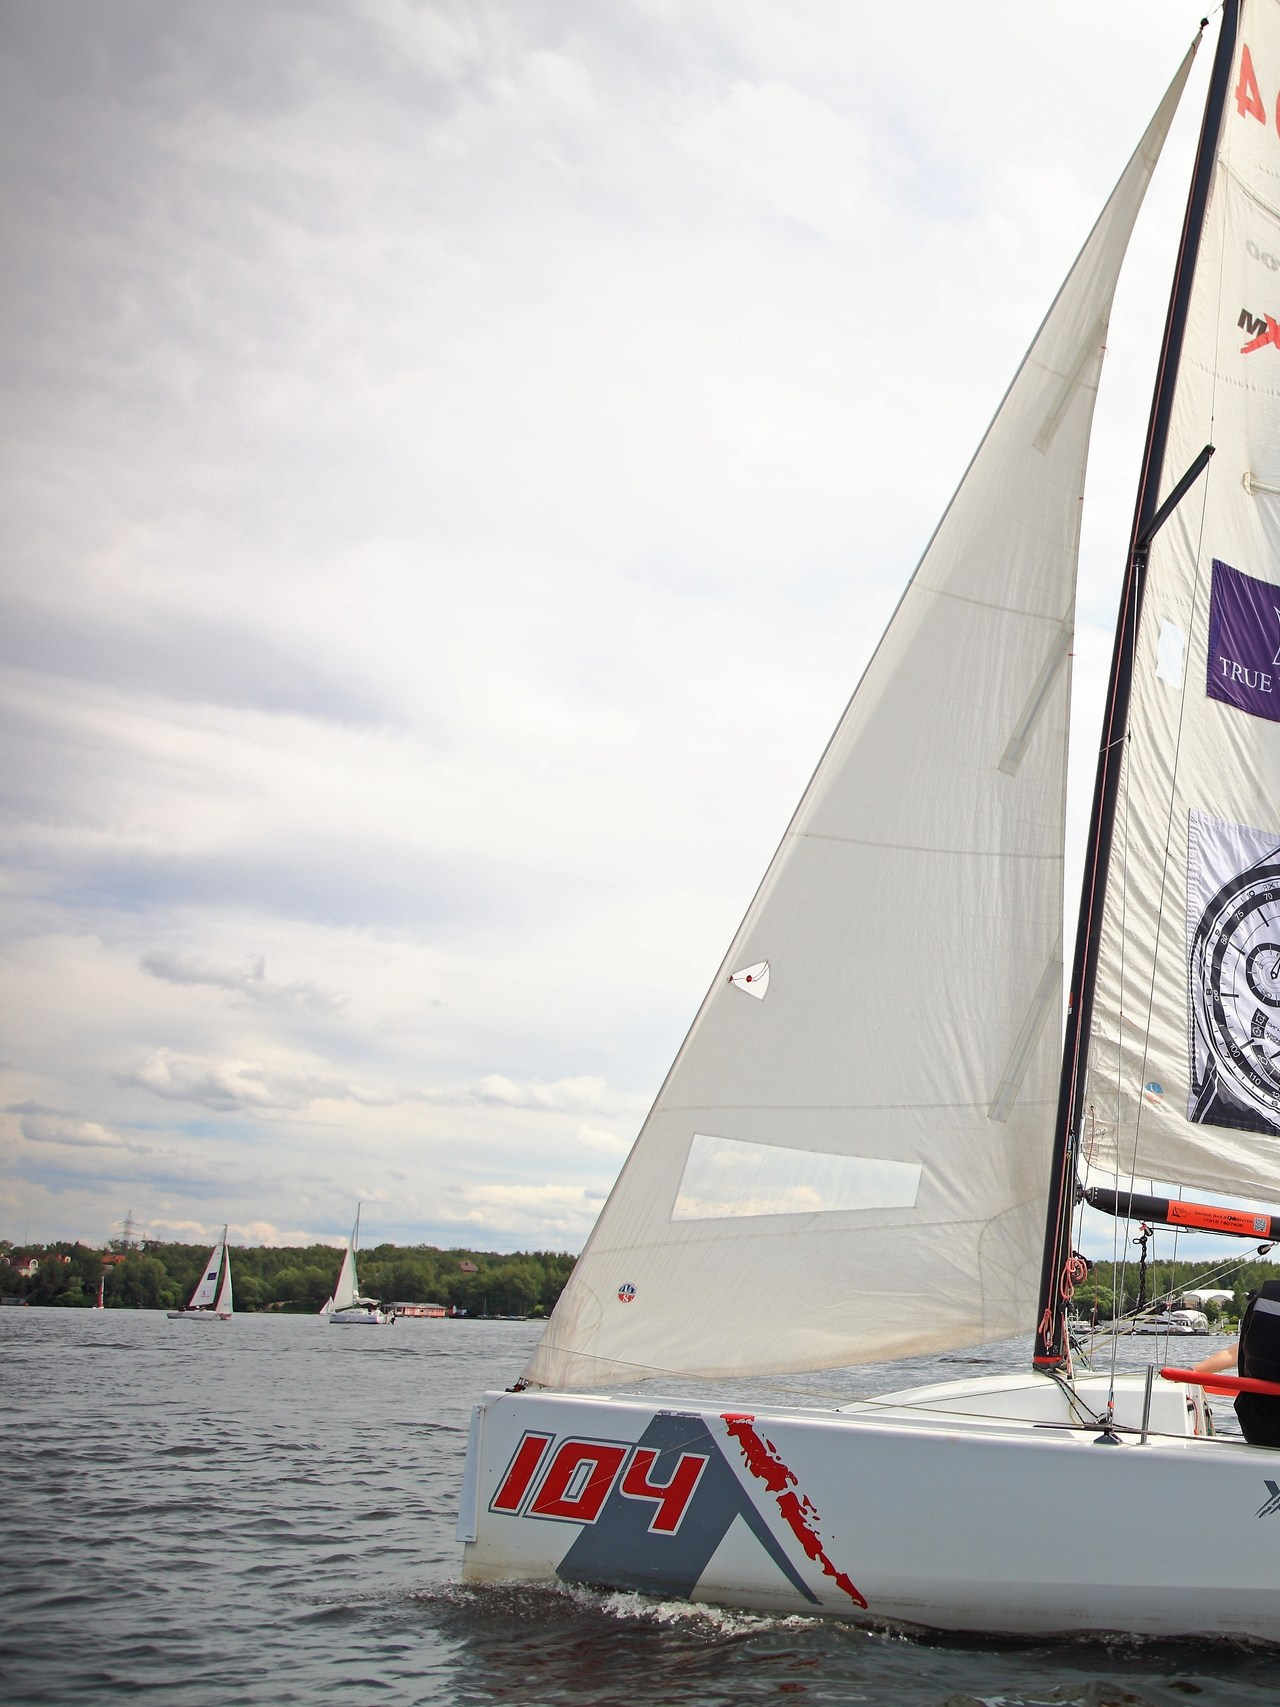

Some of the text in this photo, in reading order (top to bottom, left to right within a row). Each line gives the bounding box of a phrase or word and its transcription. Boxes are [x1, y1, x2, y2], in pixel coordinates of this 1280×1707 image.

[1219, 656, 1273, 693] TRUE
[1263, 892, 1273, 901] 70
[1234, 910, 1244, 921] 75
[1229, 1042, 1241, 1058] 100
[1249, 1071, 1261, 1086] 110
[488, 1429, 710, 1537] 104
